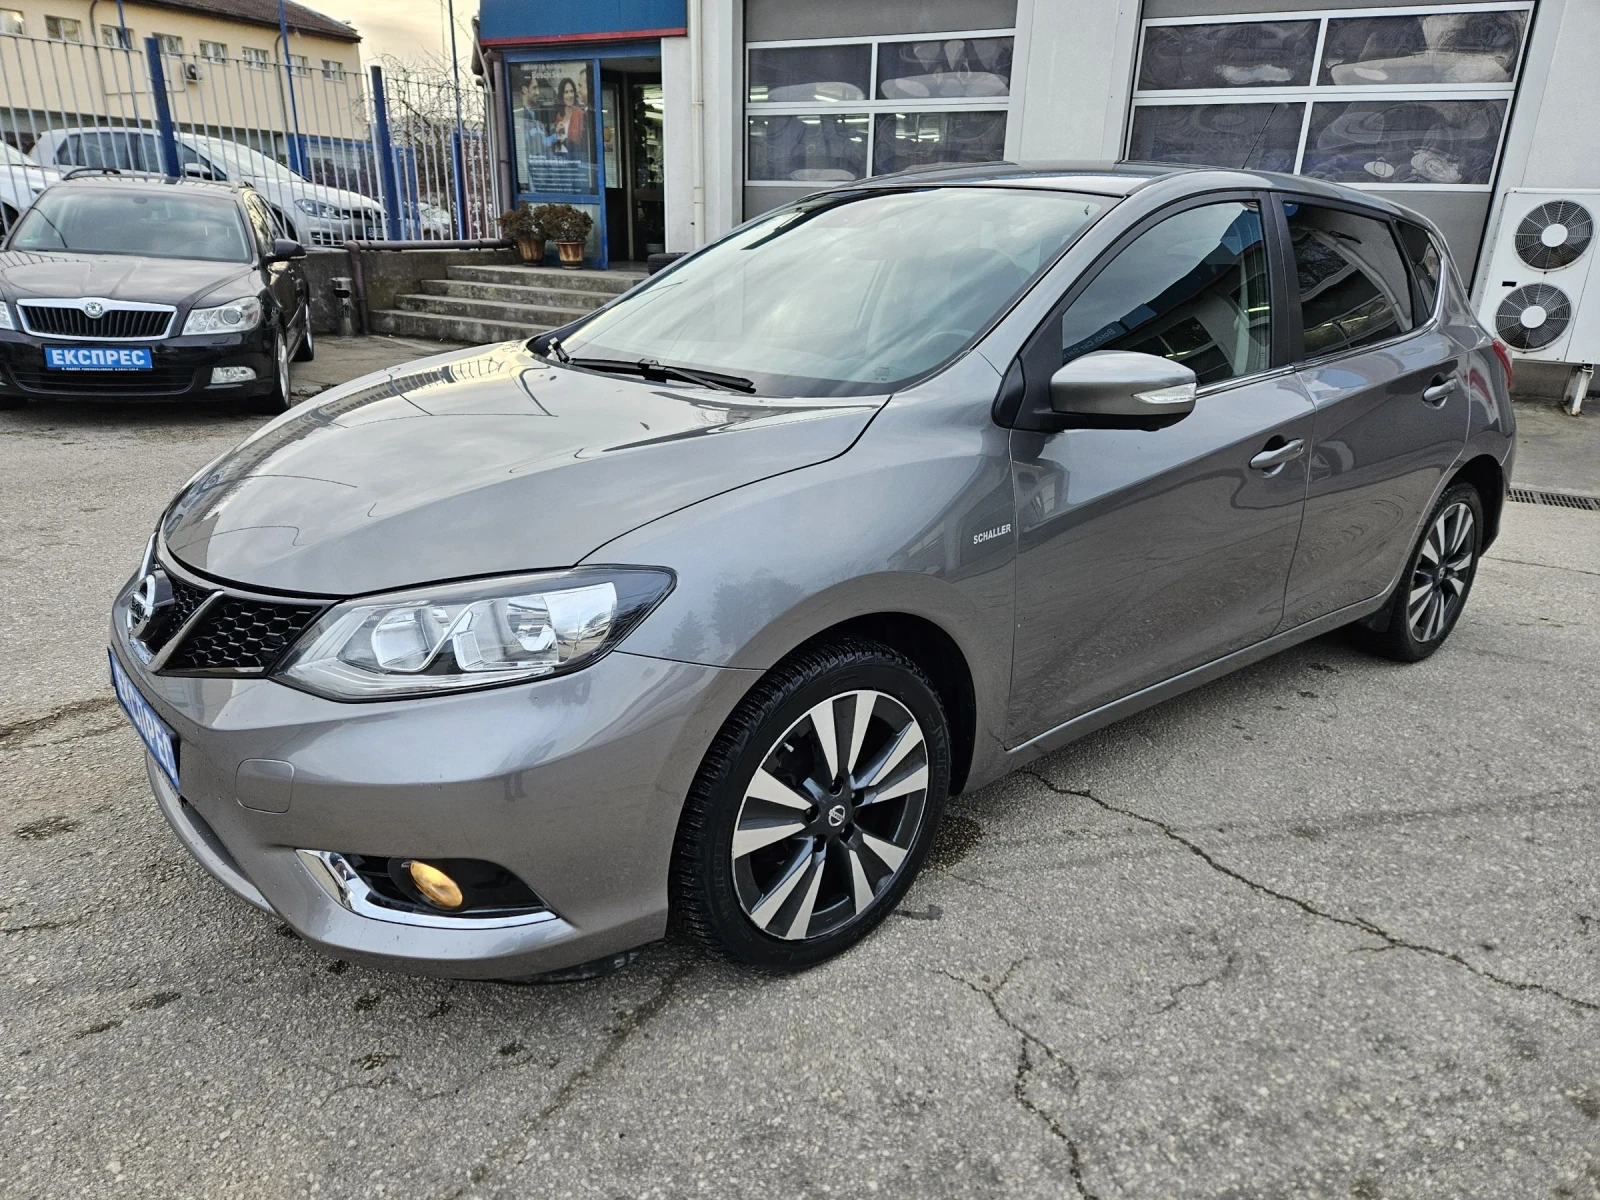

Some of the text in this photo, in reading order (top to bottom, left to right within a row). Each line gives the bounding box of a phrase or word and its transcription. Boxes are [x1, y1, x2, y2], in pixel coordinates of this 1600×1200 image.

[51, 349, 145, 365] ЕКСПРЕС
[973, 523, 1011, 545] SCHALLER
[116, 667, 176, 779] ЕКСПРЕС
